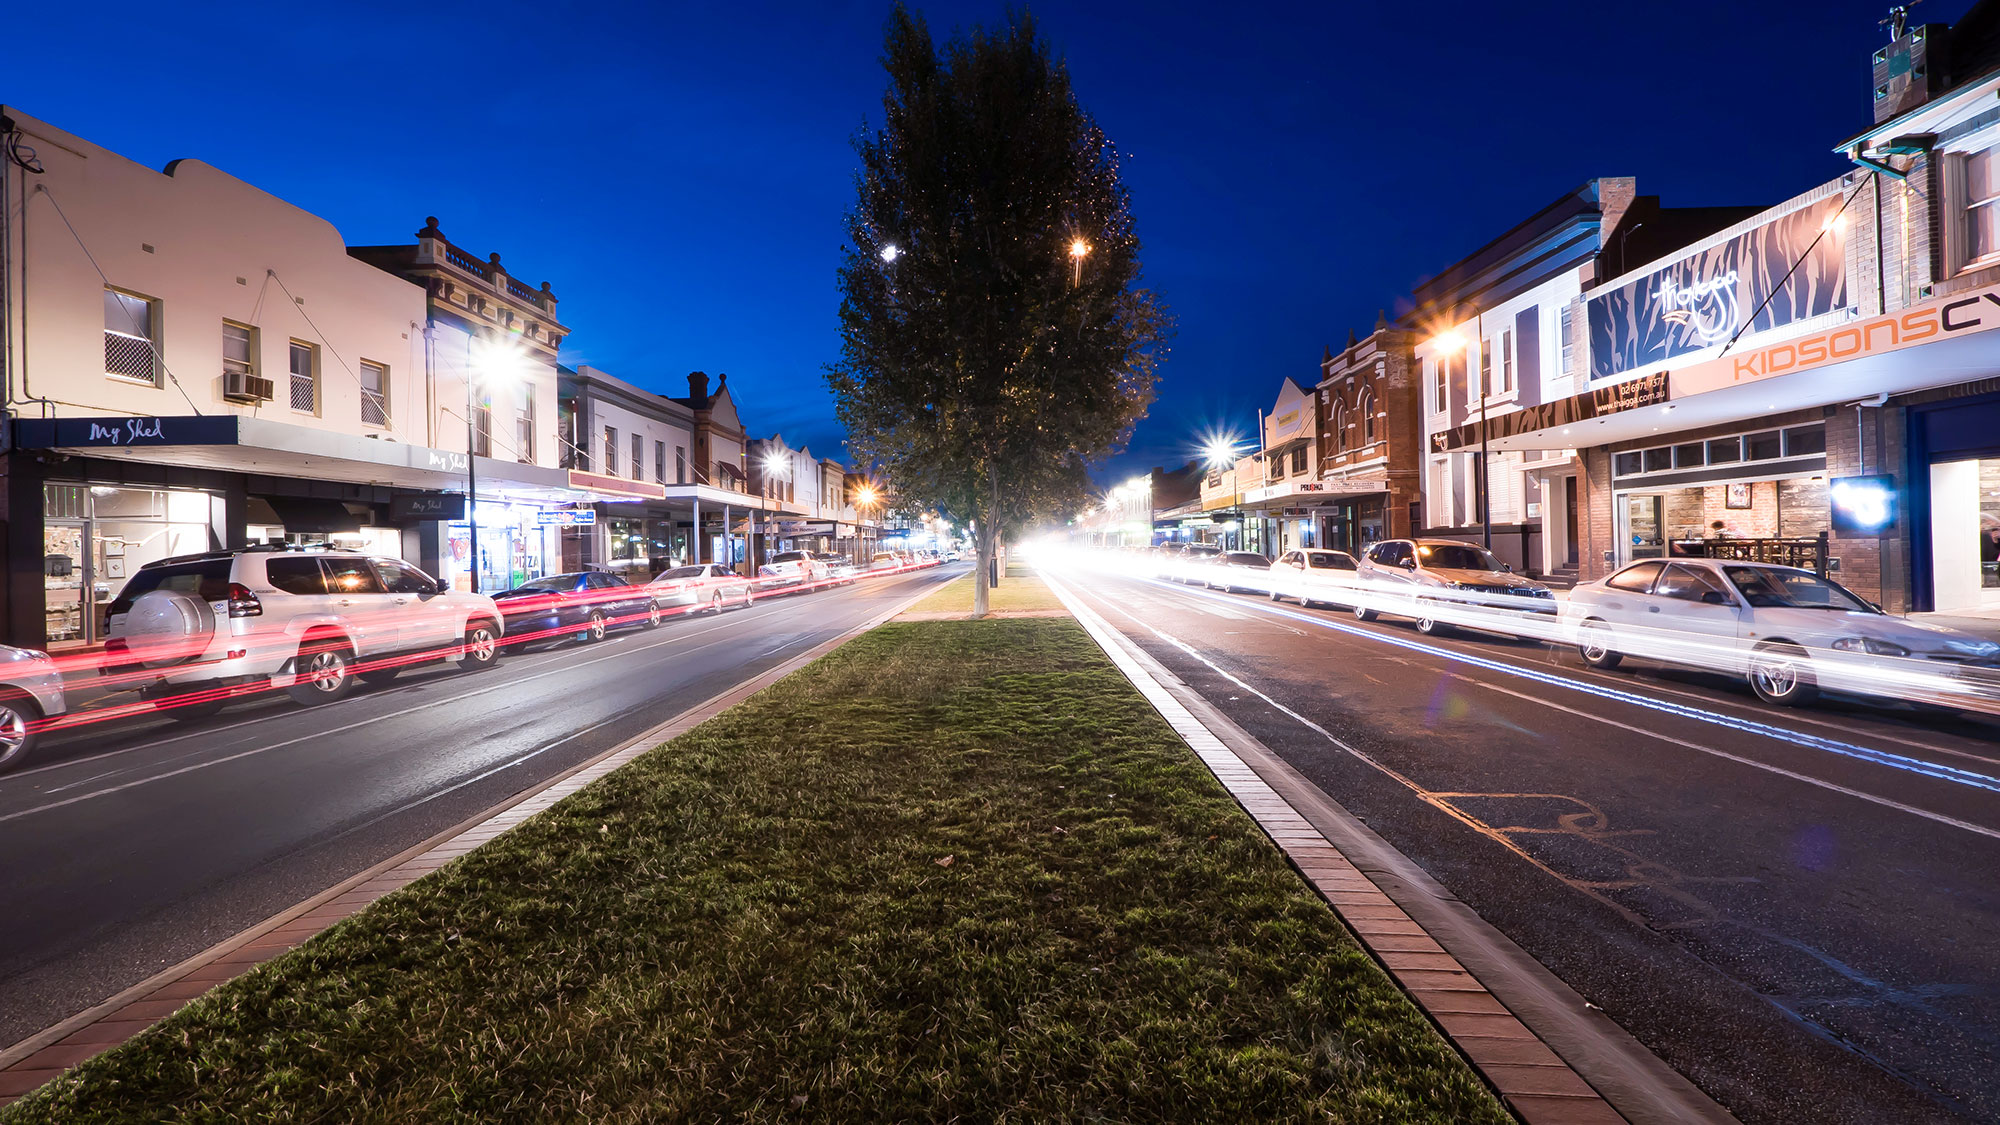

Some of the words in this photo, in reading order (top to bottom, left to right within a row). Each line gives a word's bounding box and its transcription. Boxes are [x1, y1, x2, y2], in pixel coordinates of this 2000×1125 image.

[1621, 386, 1630, 395] 02
[1631, 381, 1647, 393] 6971
[1649, 377, 1665, 388] 7371
[1596, 391, 1665, 412] www.thaigga.com.au
[89, 423, 120, 444] My
[126, 418, 165, 444] Shed
[429, 452, 446, 470] My
[449, 453, 469, 471] Shed
[412, 501, 426, 512] My
